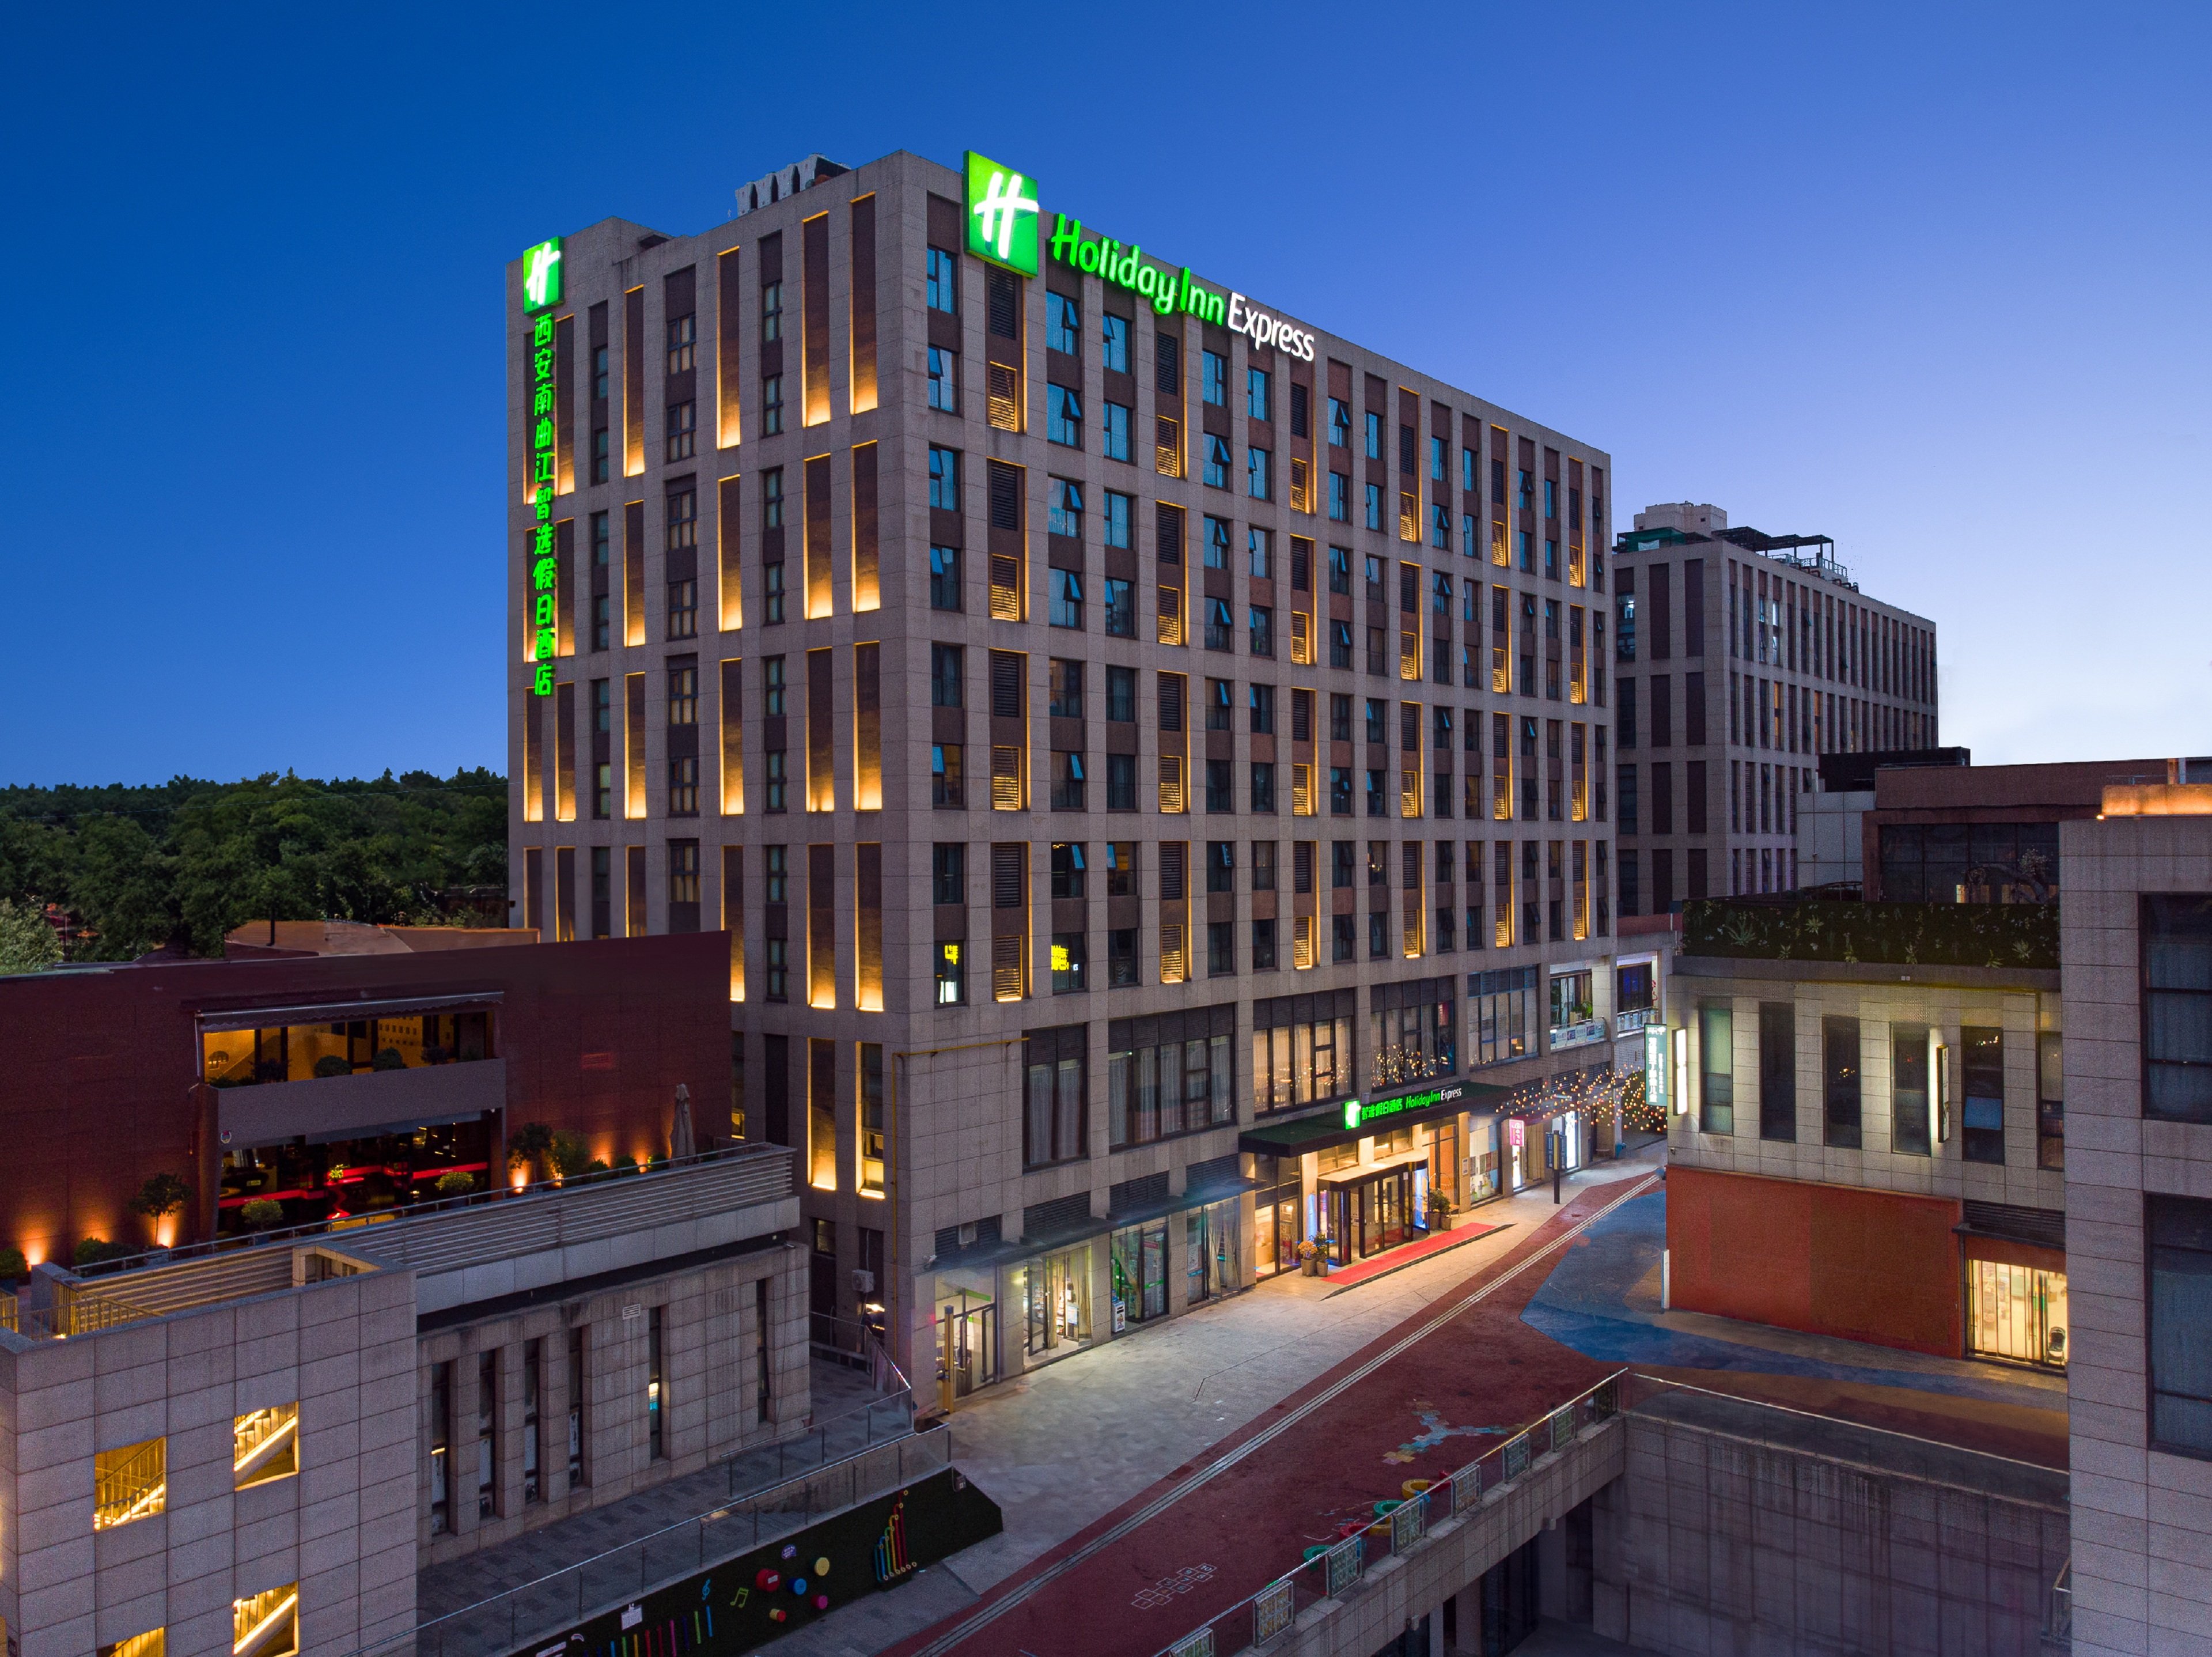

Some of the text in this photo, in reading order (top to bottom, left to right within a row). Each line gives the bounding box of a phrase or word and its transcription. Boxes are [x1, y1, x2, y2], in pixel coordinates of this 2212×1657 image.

[1050, 213, 1315, 362] Holiday Inn Express
[532, 312, 556, 696] 西安南曲江智选假日酒店
[1406, 1093, 1430, 1109] Holiday
[1430, 1091, 1440, 1102] Inn
[1441, 1088, 1462, 1102] Express
